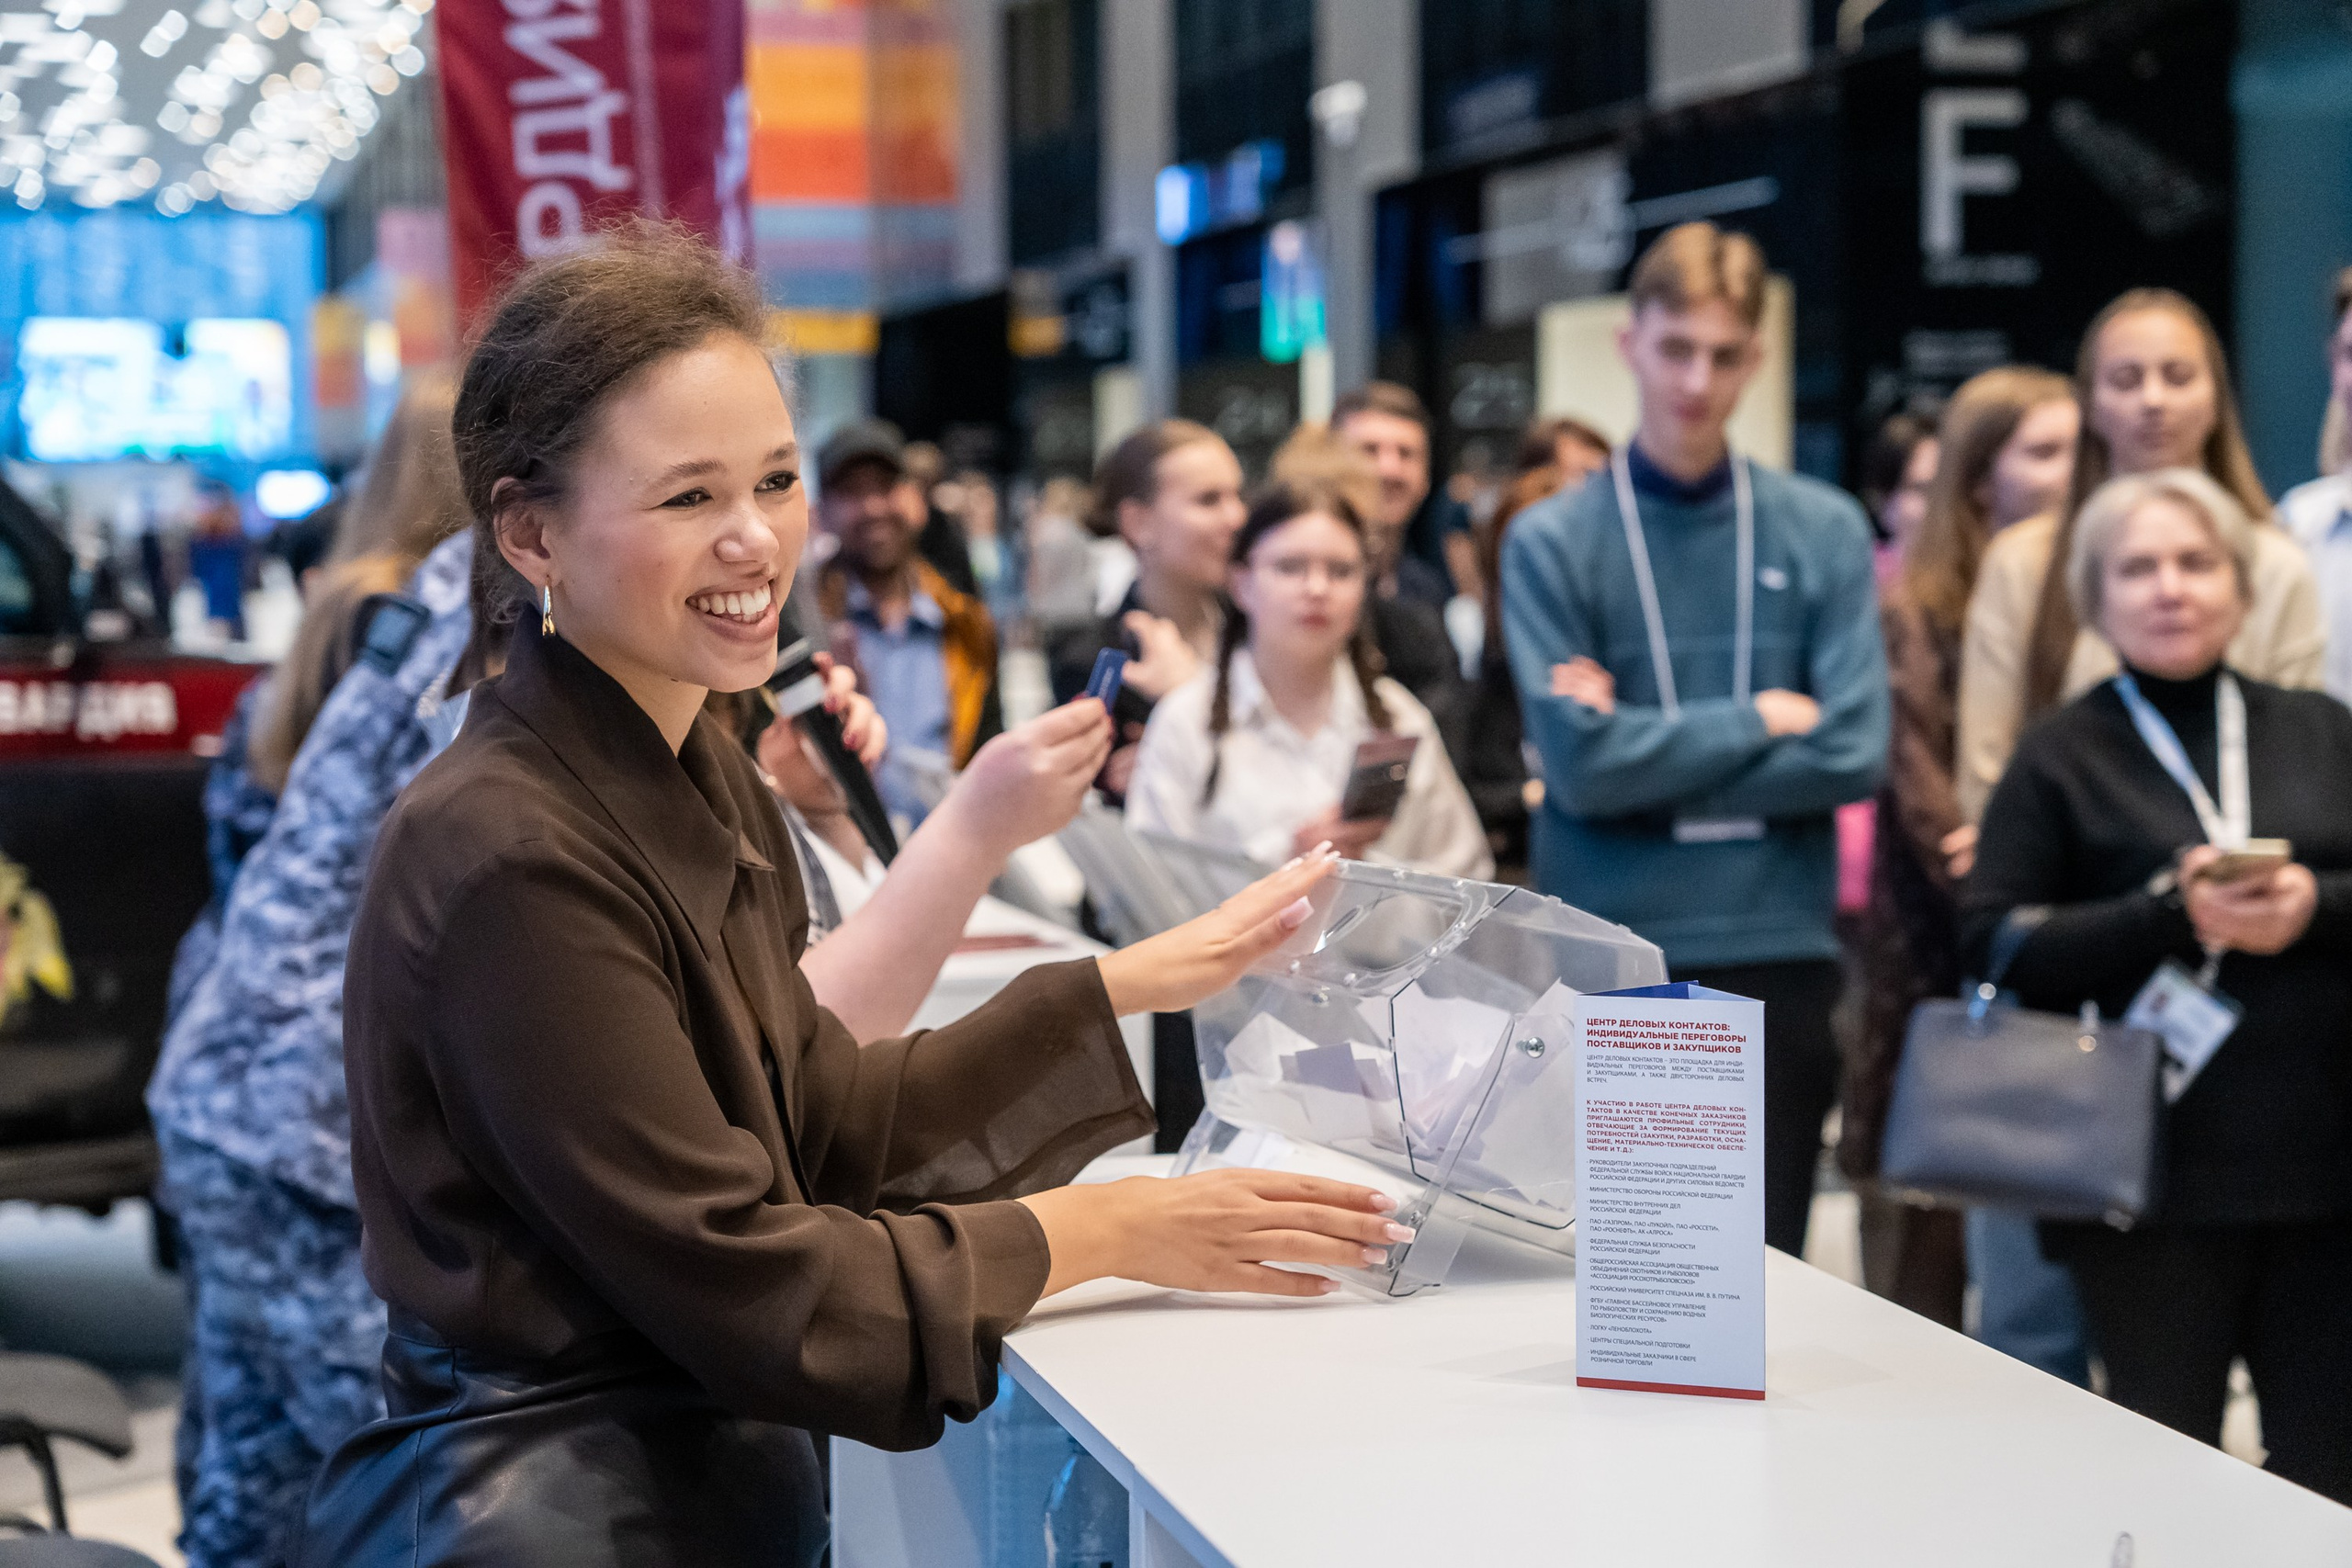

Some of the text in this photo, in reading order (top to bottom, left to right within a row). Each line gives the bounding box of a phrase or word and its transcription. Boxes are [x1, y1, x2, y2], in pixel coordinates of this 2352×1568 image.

[501, 0, 634, 258] РДИ
[1587, 1018, 1730, 1031] ЦЕНТР ДЕЛОВЫХ КОНТАКТОВ:
[1587, 1029, 1746, 1042] ИНДИВИДУАЛЬНЫЕ ПЕРЕГОВОРЫ
[1587, 1040, 1661, 1050] ПОСТАВЩИКОВ
[1673, 1043, 1741, 1053] ЗАКУПЩИКОВ
